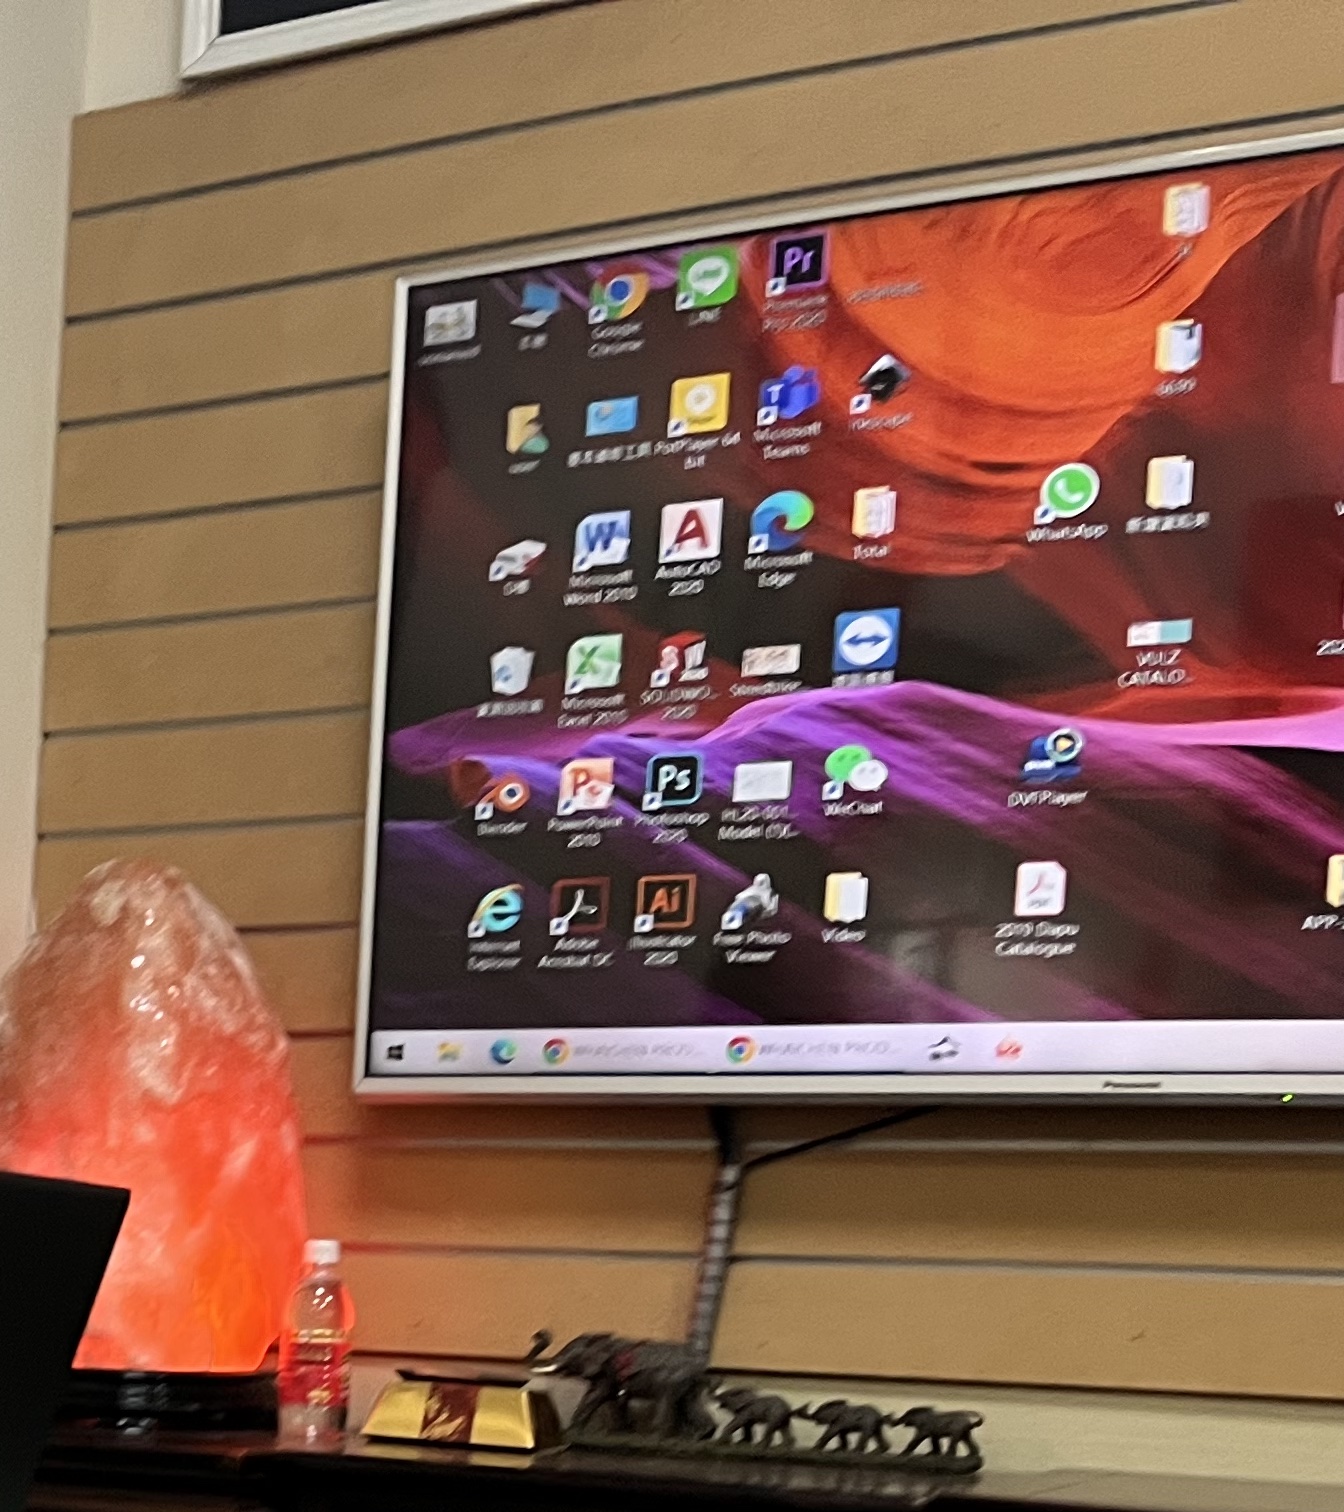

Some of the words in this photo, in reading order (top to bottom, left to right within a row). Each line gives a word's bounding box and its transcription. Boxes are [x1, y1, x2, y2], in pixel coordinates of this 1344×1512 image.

[784, 246, 815, 276] Pr
[1026, 523, 1108, 542] WhatsApp
[655, 559, 722, 581] AutoCAD
[658, 763, 691, 793] Ps
[823, 800, 883, 817] WeChat
